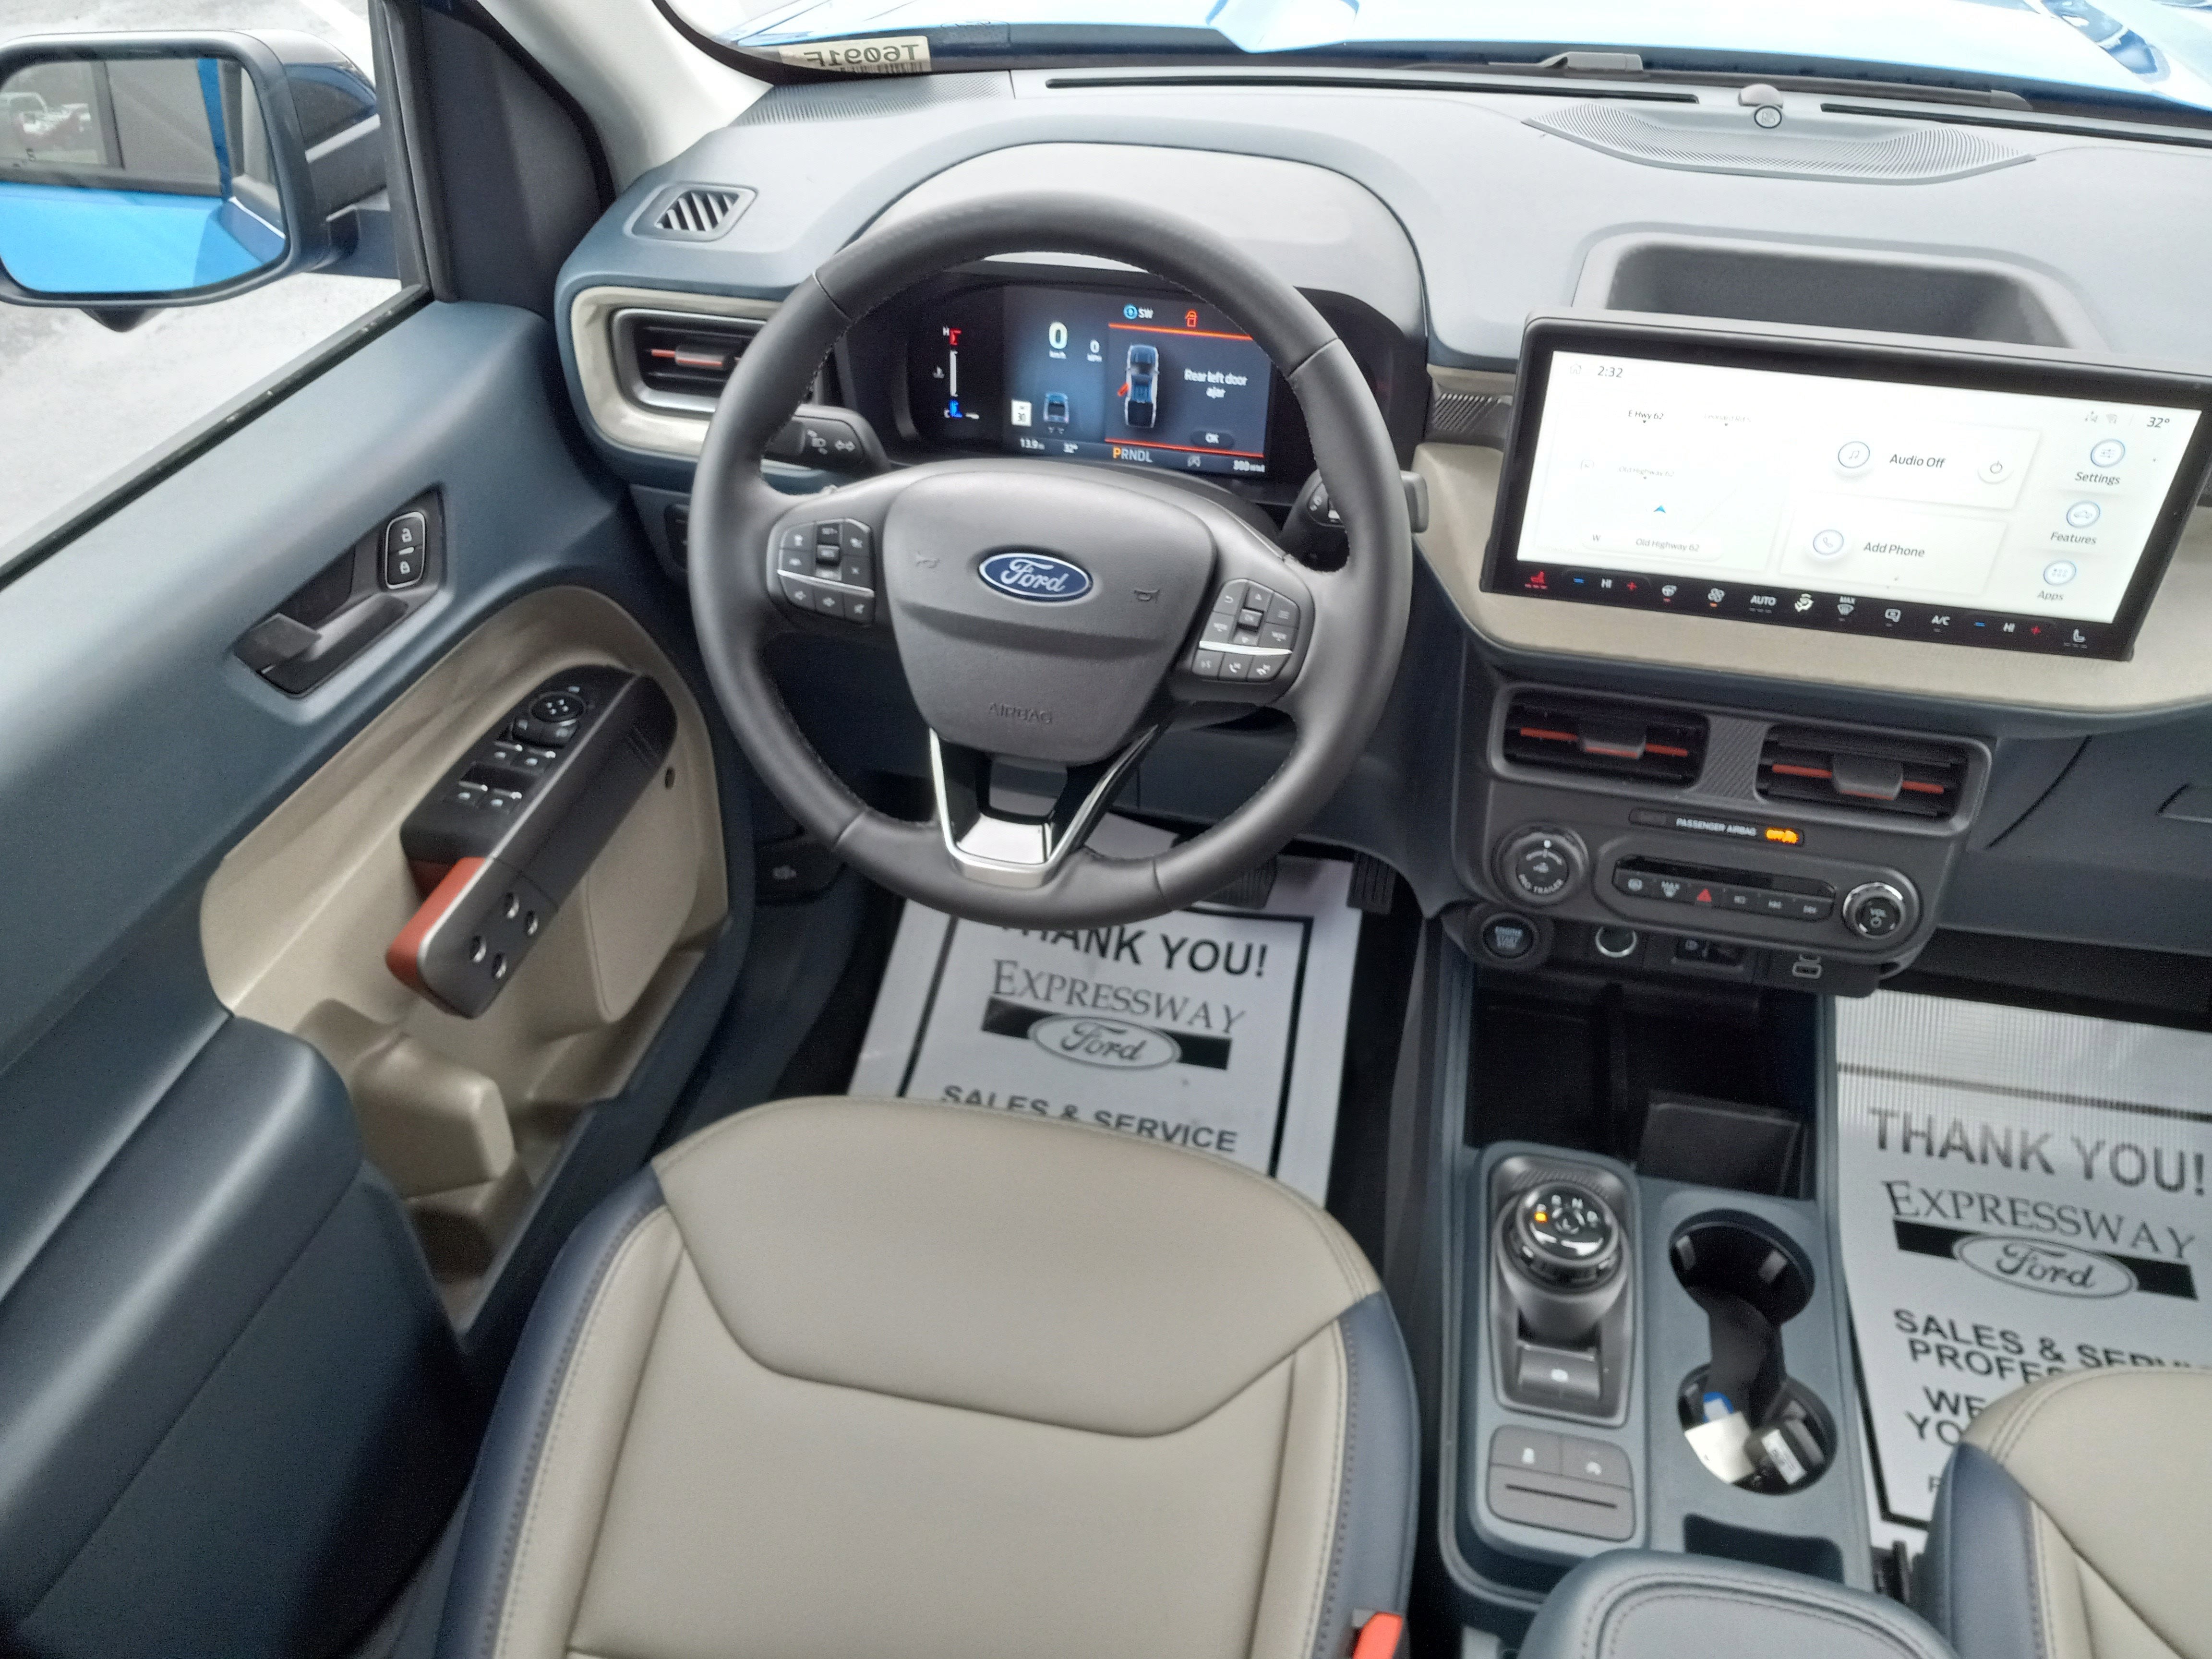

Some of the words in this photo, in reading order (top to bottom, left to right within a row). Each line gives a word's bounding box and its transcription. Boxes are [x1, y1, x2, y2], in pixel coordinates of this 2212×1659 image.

[1049, 322, 1068, 349] 0
[1090, 339, 1100, 353] 0
[1184, 368, 1207, 382] Rear
[1207, 370, 1225, 384] left
[1225, 372, 1248, 385] door
[1597, 365, 1623, 378] 2:32
[1206, 386, 1226, 399] ajar
[1635, 410, 1651, 420] Hwy
[1653, 412, 1664, 420] 62
[2146, 416, 2170, 428] 32°
[1113, 446, 1153, 463] PRNDL
[1889, 453, 1923, 467] Audio
[1926, 457, 1946, 469] Off
[2075, 471, 2120, 486] Settings
[1592, 534, 1601, 542] W
[1636, 538, 1651, 547] Old
[1652, 539, 1688, 552] Highway
[1689, 542, 1700, 552] 62
[2050, 531, 2097, 546] Features
[1863, 541, 1887, 554] Add
[1889, 544, 1925, 558] Phone
[1000, 558, 1070, 592] Ford
[1601, 578, 1612, 589] HI
[1750, 594, 1776, 606] AUTO
[2037, 590, 2064, 602] Apps
[1931, 615, 1950, 626] A/C
[2003, 622, 2015, 633] HI
[988, 702, 1054, 724] AIRBAG
[1676, 817, 1726, 832] PASSENGER
[1726, 824, 1757, 837] AIRBAG
[1010, 924, 1146, 965] ANK
[1160, 933, 1267, 978] YOU!
[992, 958, 1247, 1034] EXPRESSWAY
[1060, 1020, 1148, 1063] Ford
[1094, 1109, 1238, 1152] SERVICE
[1868, 1106, 2056, 1176] THANK
[2070, 1134, 2206, 1197] YOU!
[1881, 1179, 2196, 1260] EXPRESSWAY
[1996, 1241, 2096, 1288] Ford
[1893, 1307, 2024, 1356] SALES
[2040, 1336, 2066, 1364] &
